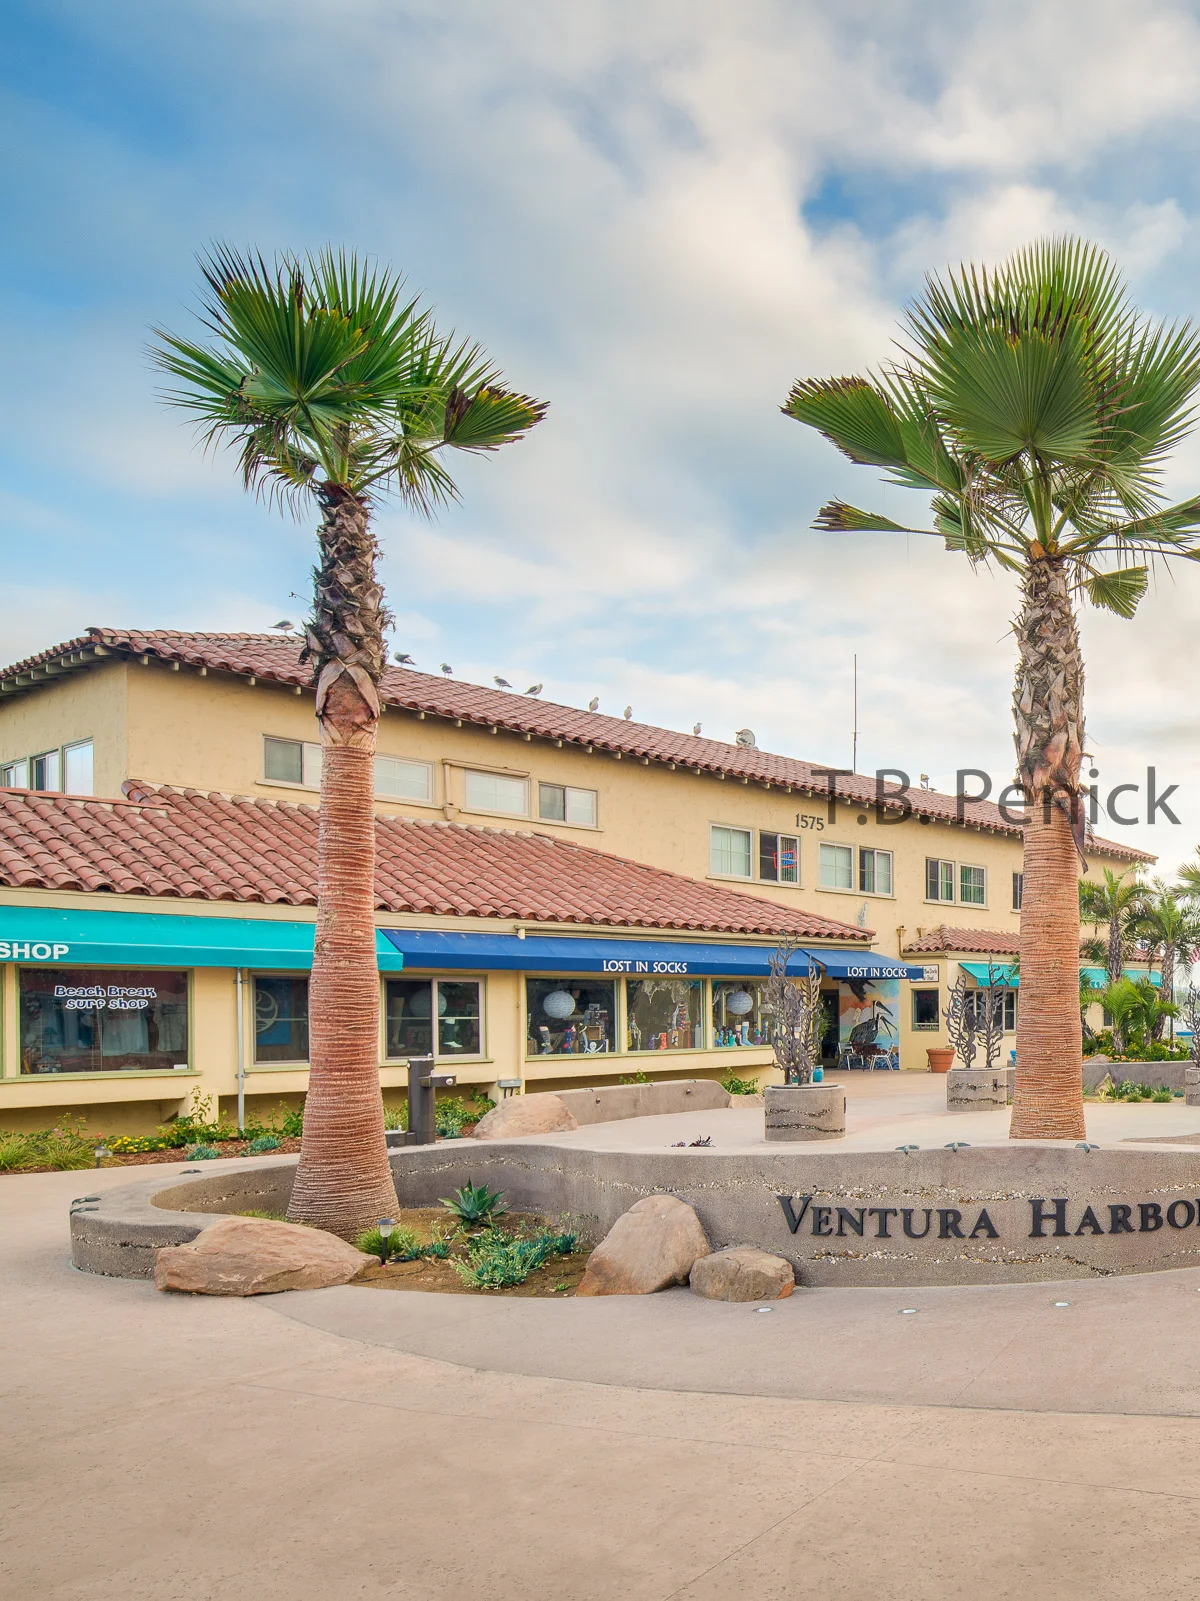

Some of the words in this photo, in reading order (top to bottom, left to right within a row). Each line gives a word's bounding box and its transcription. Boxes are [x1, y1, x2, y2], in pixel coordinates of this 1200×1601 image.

[795, 812, 825, 831] 1575
[0, 942, 69, 959] SHOP
[603, 959, 632, 972] LOST
[635, 960, 648, 973] IN
[652, 961, 687, 974] SOCKS
[847, 966, 868, 977] LOST
[870, 967, 880, 977] IN
[882, 967, 907, 978] SOCKS
[54, 985, 106, 997] Beach
[107, 985, 157, 998] Break
